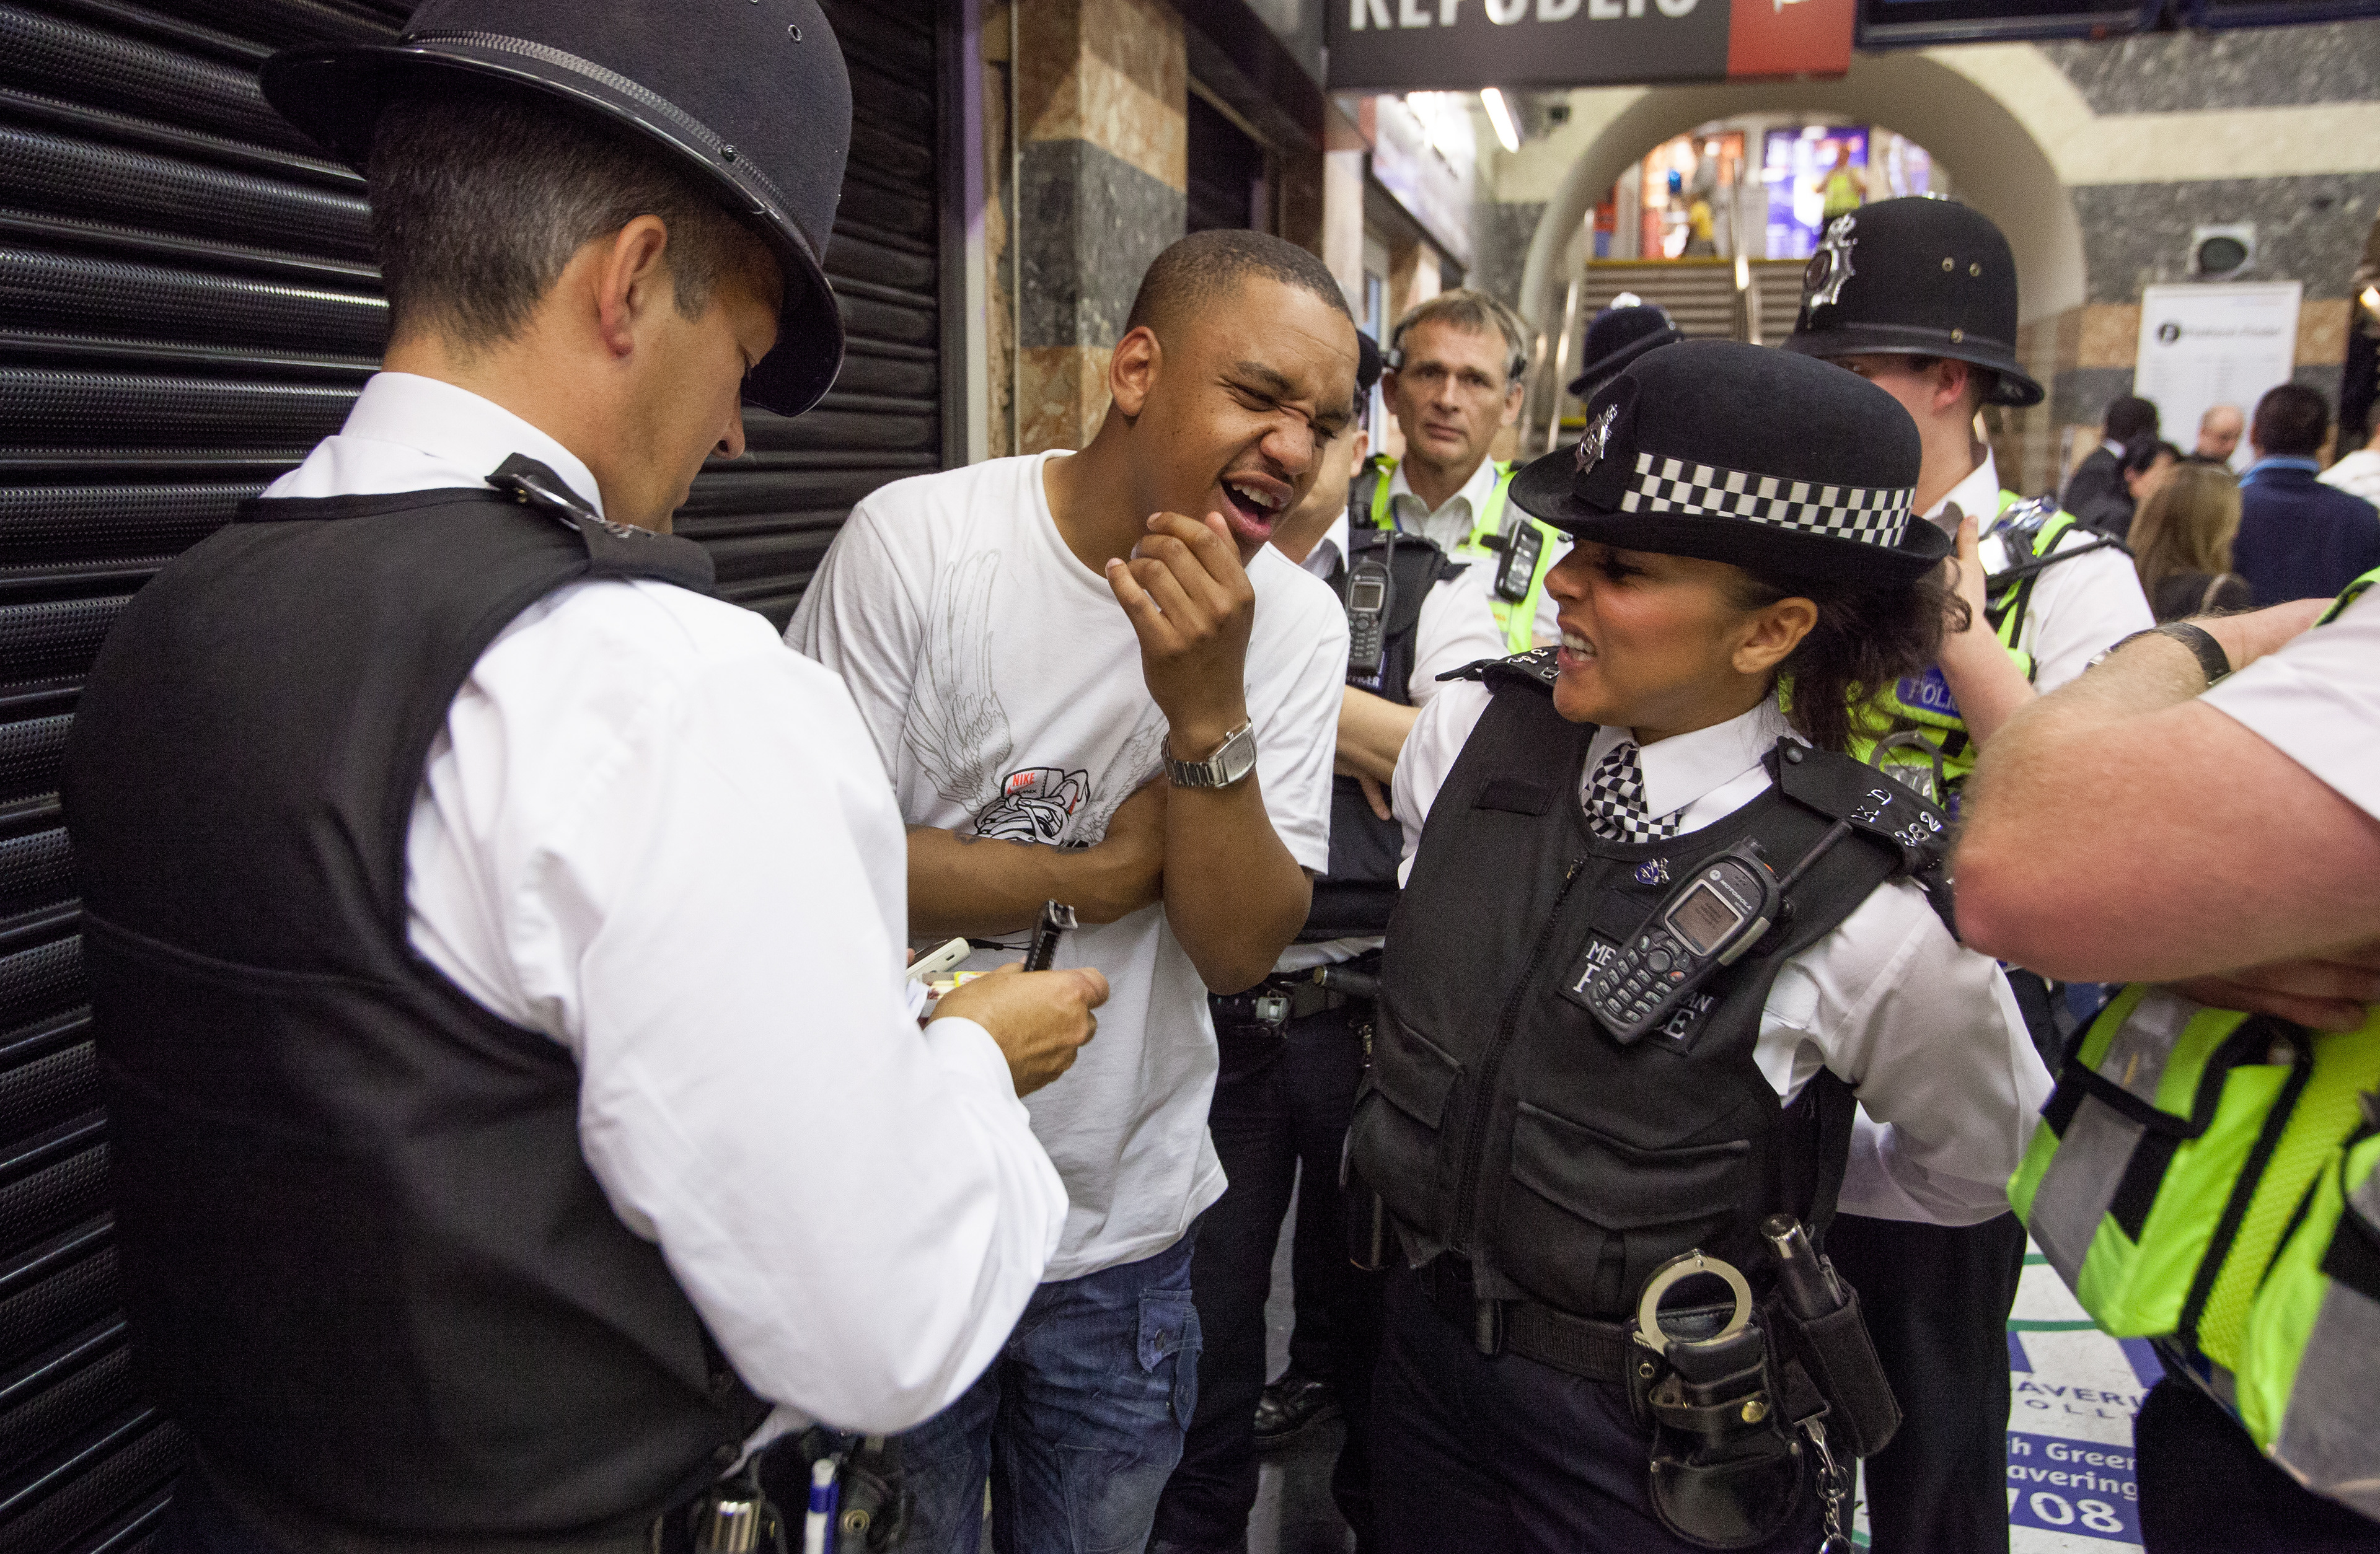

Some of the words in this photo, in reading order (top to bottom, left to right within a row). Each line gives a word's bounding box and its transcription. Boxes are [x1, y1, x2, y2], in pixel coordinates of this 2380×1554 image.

[1011, 772, 1036, 787] NIKE
[1720, 879, 1753, 911] MOTOROLA
[2006, 1464, 2138, 1501] avering
